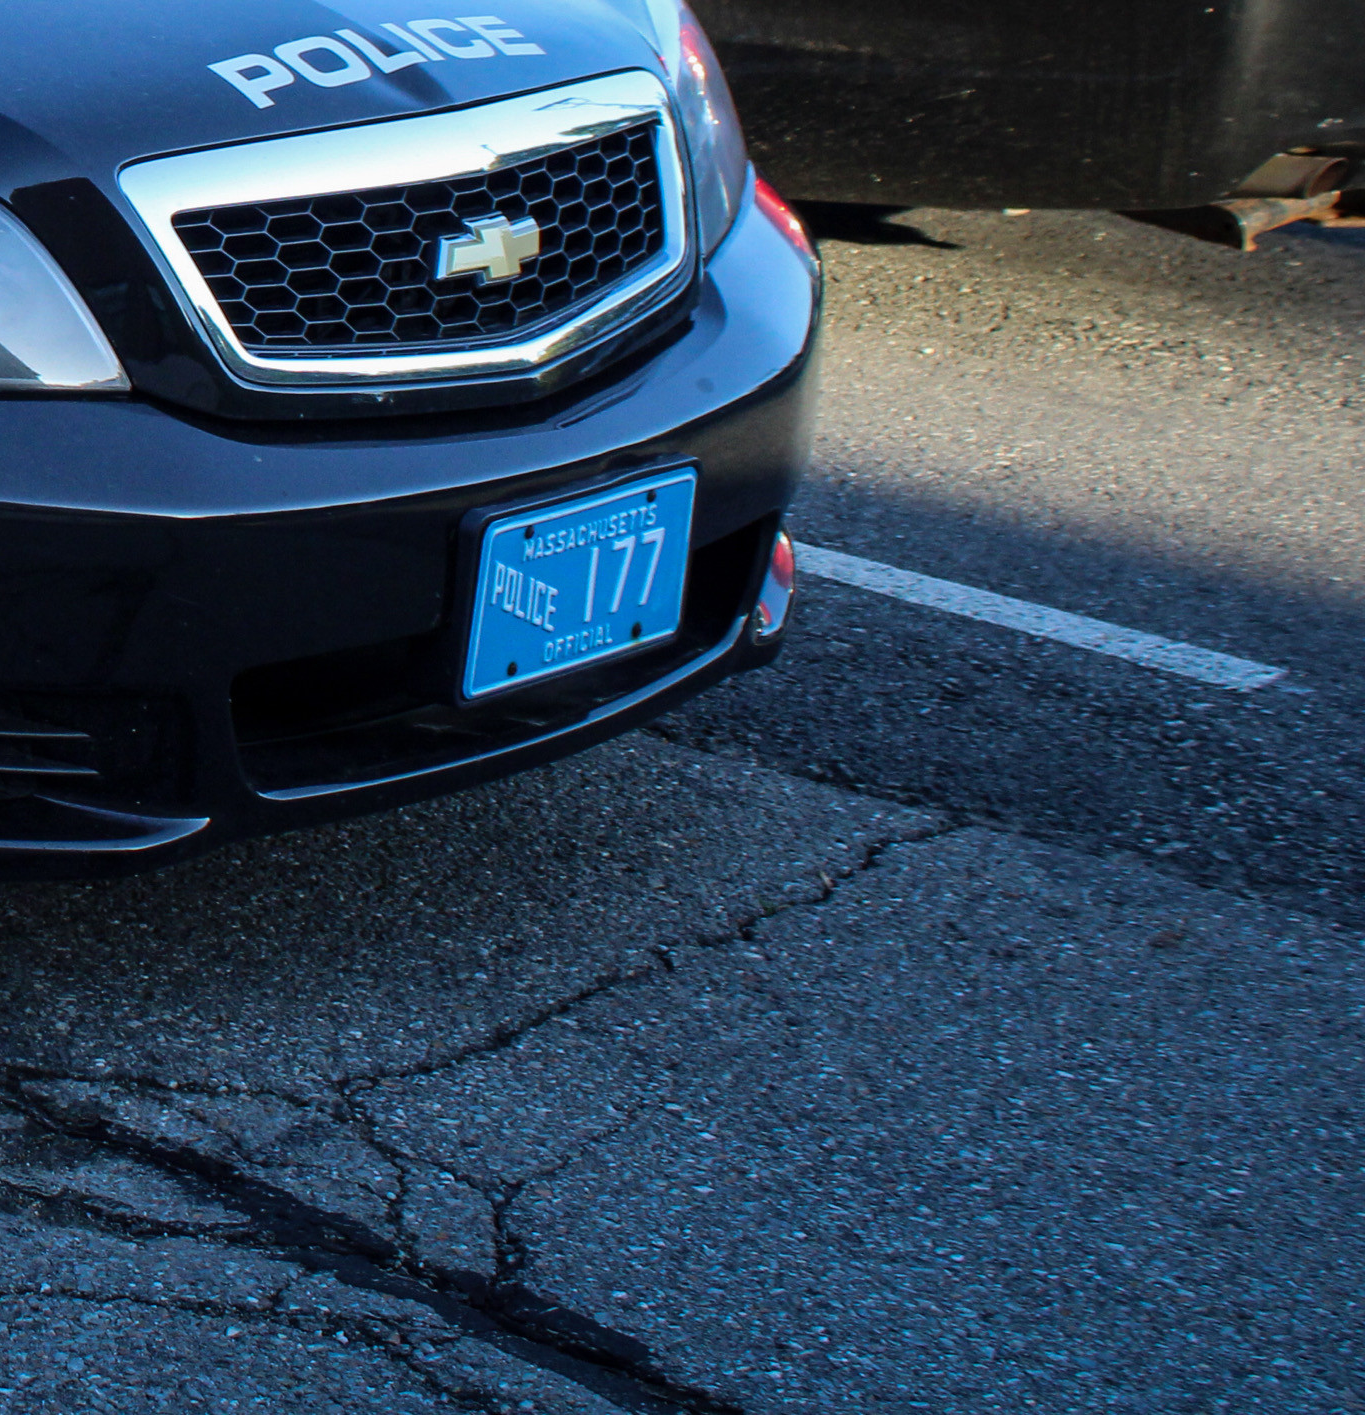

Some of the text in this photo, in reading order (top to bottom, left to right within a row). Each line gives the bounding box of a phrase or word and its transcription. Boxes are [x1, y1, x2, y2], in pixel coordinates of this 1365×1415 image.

[206, 13, 548, 108] POLICE
[522, 503, 659, 562] MASSACHUSETTS
[490, 526, 667, 633] POLICE 177
[541, 624, 614, 664] OFFICIAL
